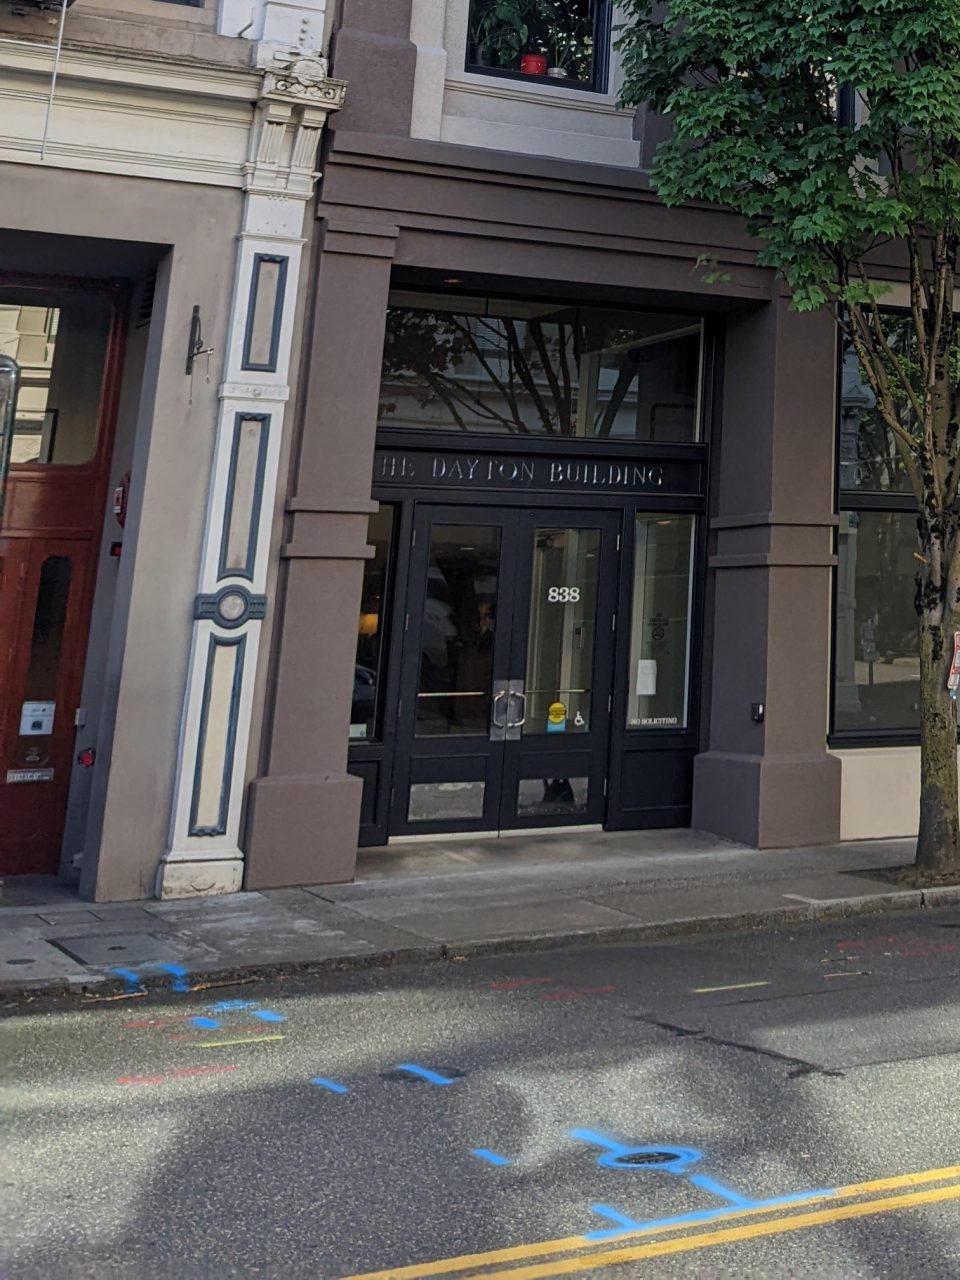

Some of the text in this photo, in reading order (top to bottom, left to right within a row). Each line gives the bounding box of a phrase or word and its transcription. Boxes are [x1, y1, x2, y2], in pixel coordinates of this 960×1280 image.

[432, 458, 535, 481] DAYTON
[550, 462, 663, 486] BUILDING
[548, 586, 580, 602] 838
